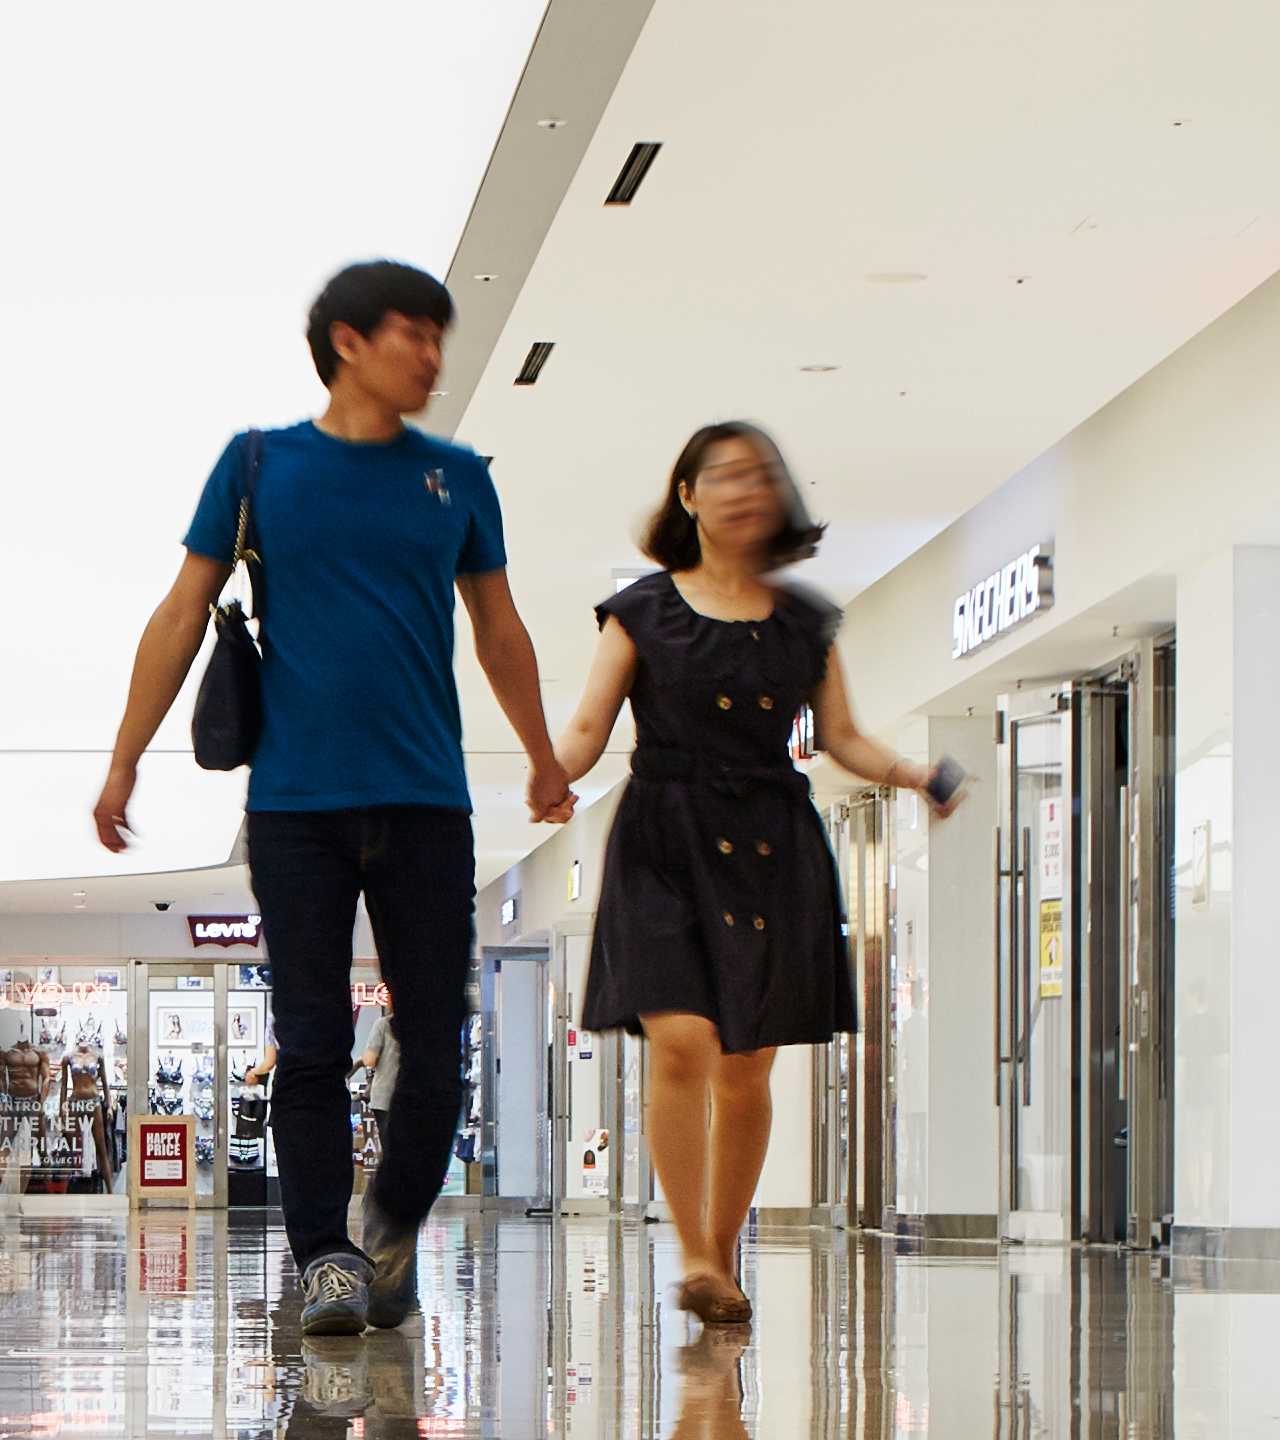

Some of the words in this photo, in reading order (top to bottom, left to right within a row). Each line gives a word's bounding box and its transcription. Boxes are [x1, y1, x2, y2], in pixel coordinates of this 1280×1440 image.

[951, 544, 1040, 659] SKECHERS
[0, 1116, 40, 1131] THE
[50, 1116, 94, 1131] NEW
[146, 1132, 181, 1144] HAPPY
[146, 1144, 181, 1156] PRICE
